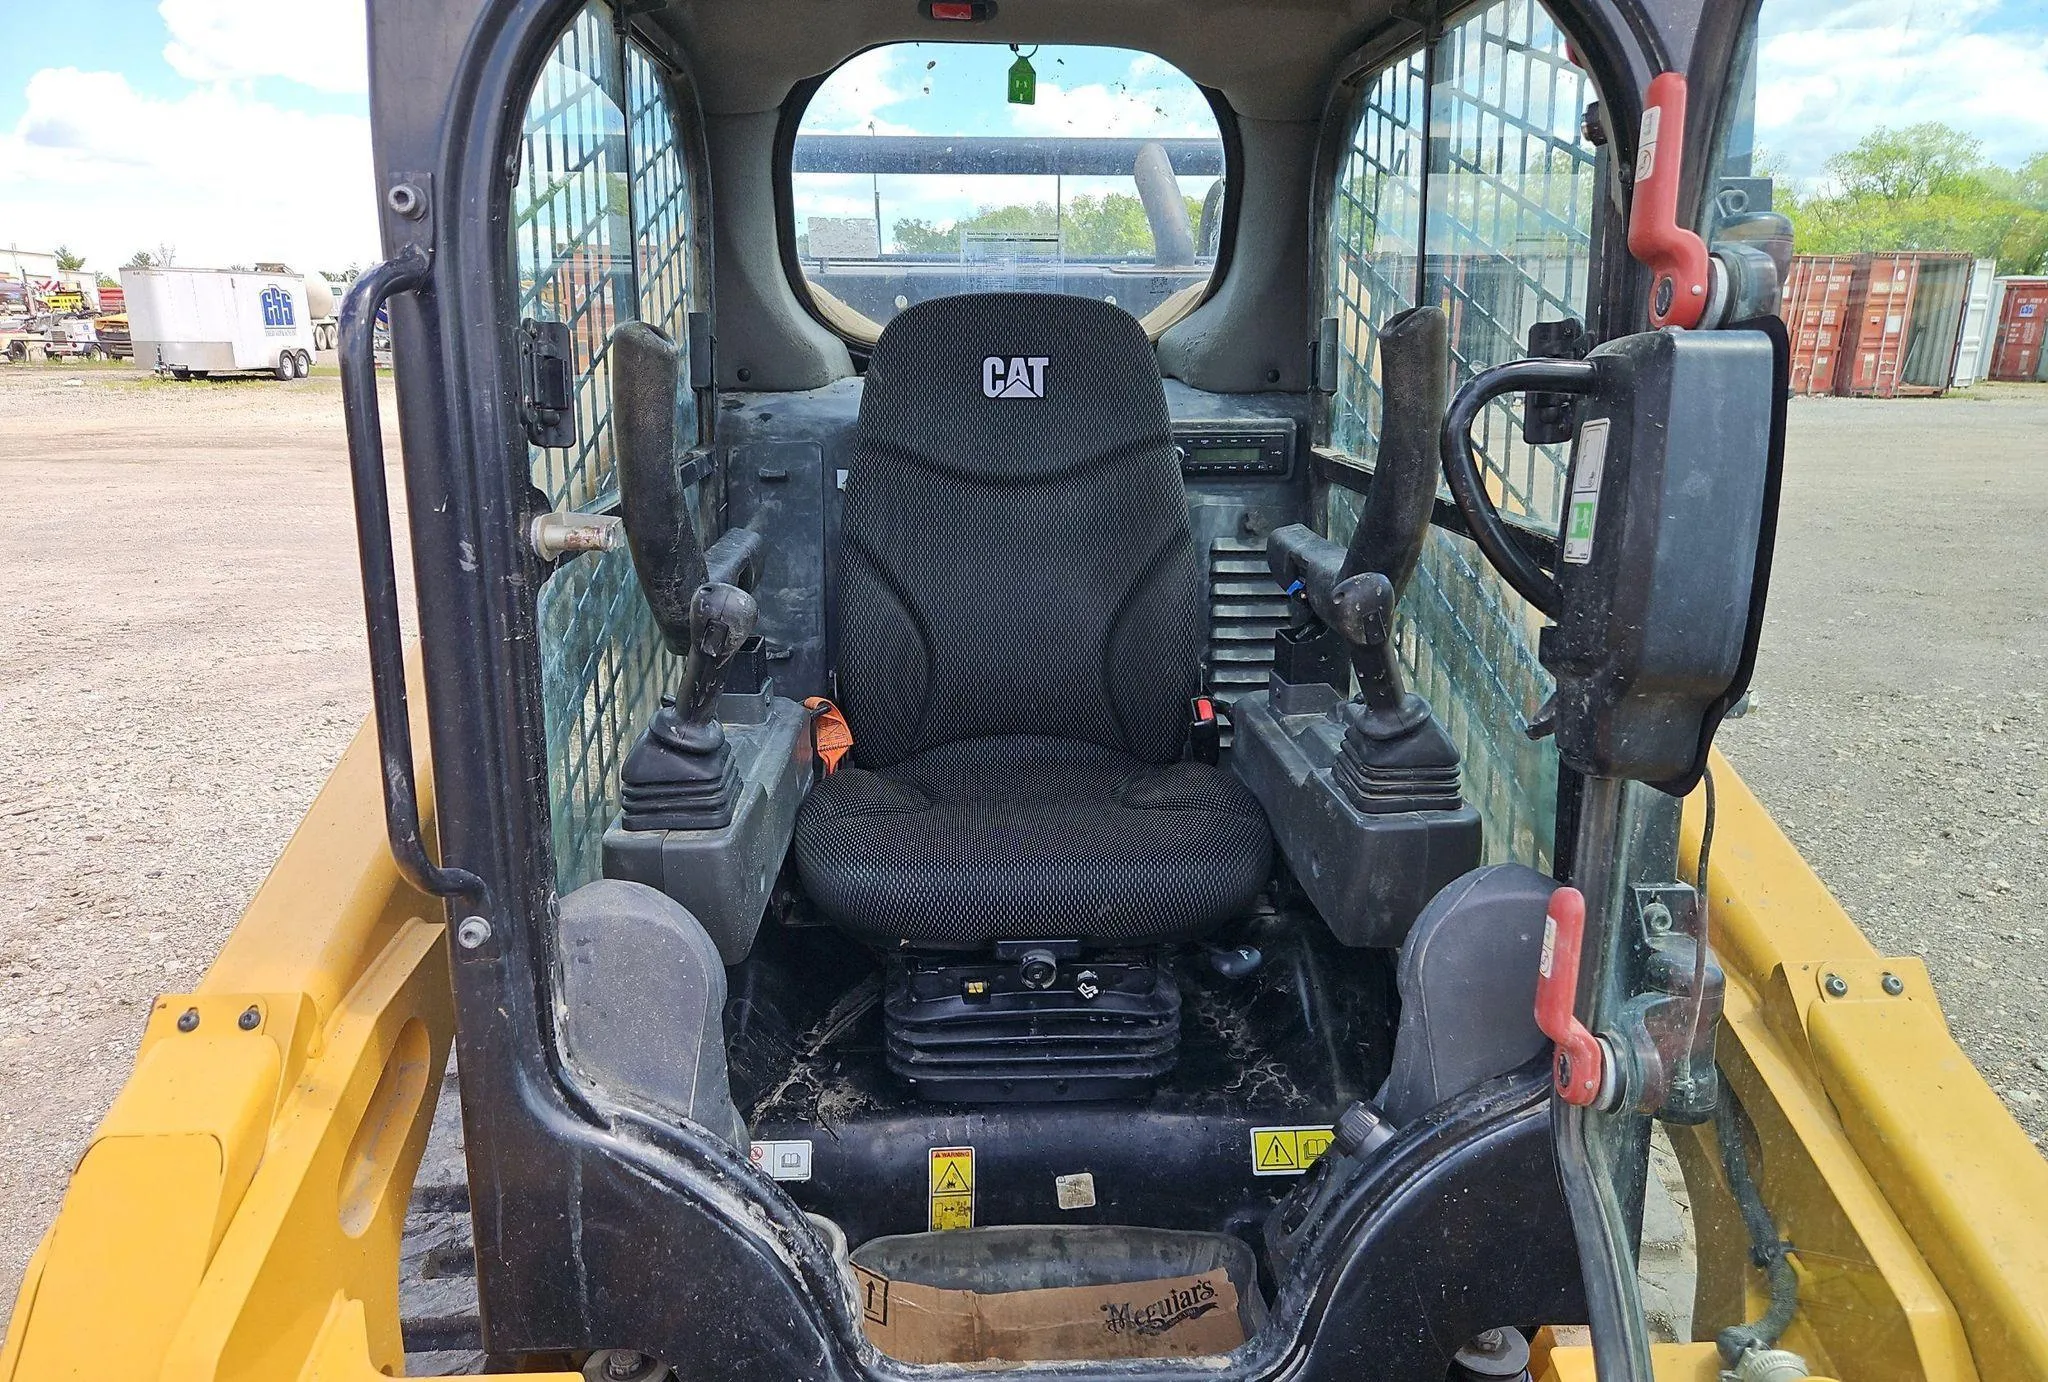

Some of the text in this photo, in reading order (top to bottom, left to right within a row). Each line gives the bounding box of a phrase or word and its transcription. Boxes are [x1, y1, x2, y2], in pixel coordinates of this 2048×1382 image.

[261, 288, 294, 325] ESS
[983, 356, 1049, 398] CAT
[942, 1151, 970, 1159] WARNING
[1099, 1279, 1216, 1335] Meguiar's
